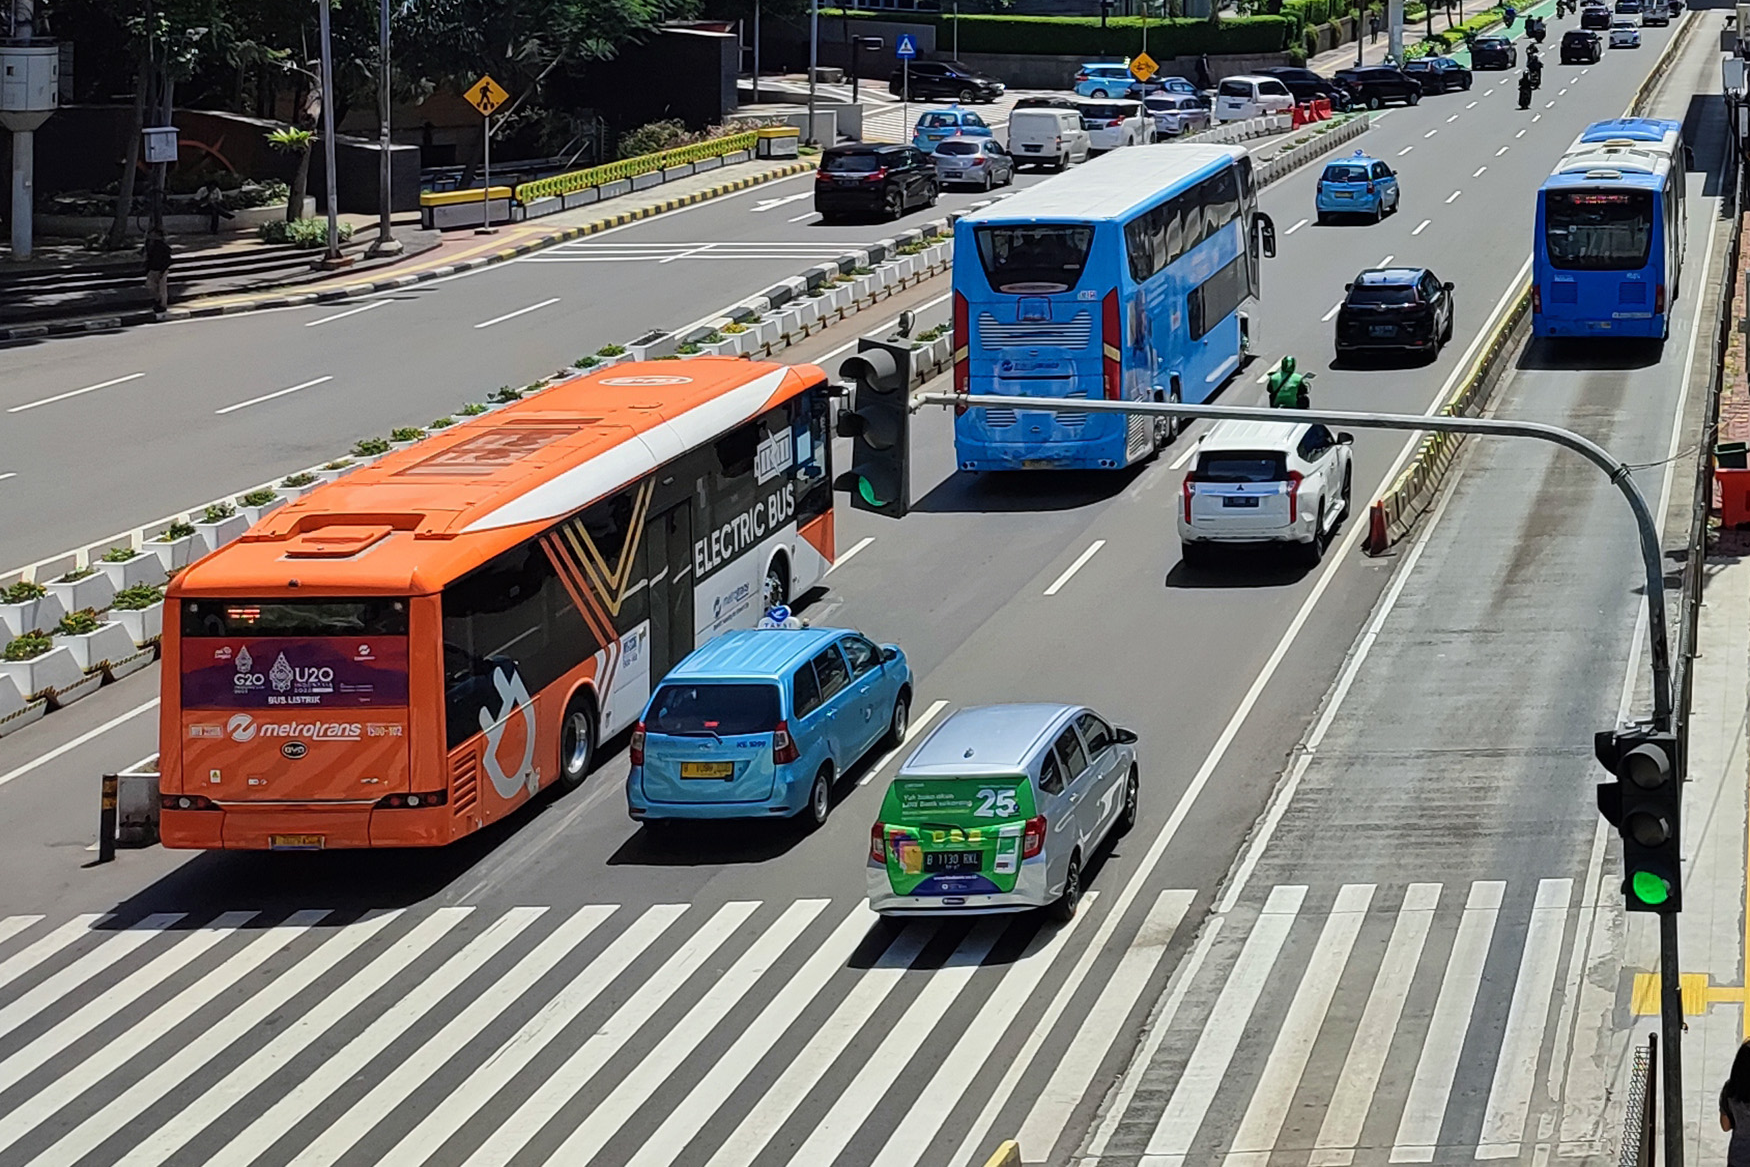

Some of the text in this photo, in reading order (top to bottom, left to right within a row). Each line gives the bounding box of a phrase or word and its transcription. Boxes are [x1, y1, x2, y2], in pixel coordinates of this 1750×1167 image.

[694, 482, 796, 579] ELECTRIC BUS
[233, 673, 265, 686] G20
[294, 667, 334, 683] U20
[268, 695, 321, 704] BUS LISTRIK
[260, 720, 362, 741] metrotrans
[974, 789, 1016, 817] 25
[927, 855, 933, 865] B
[938, 854, 959, 865] 1130
